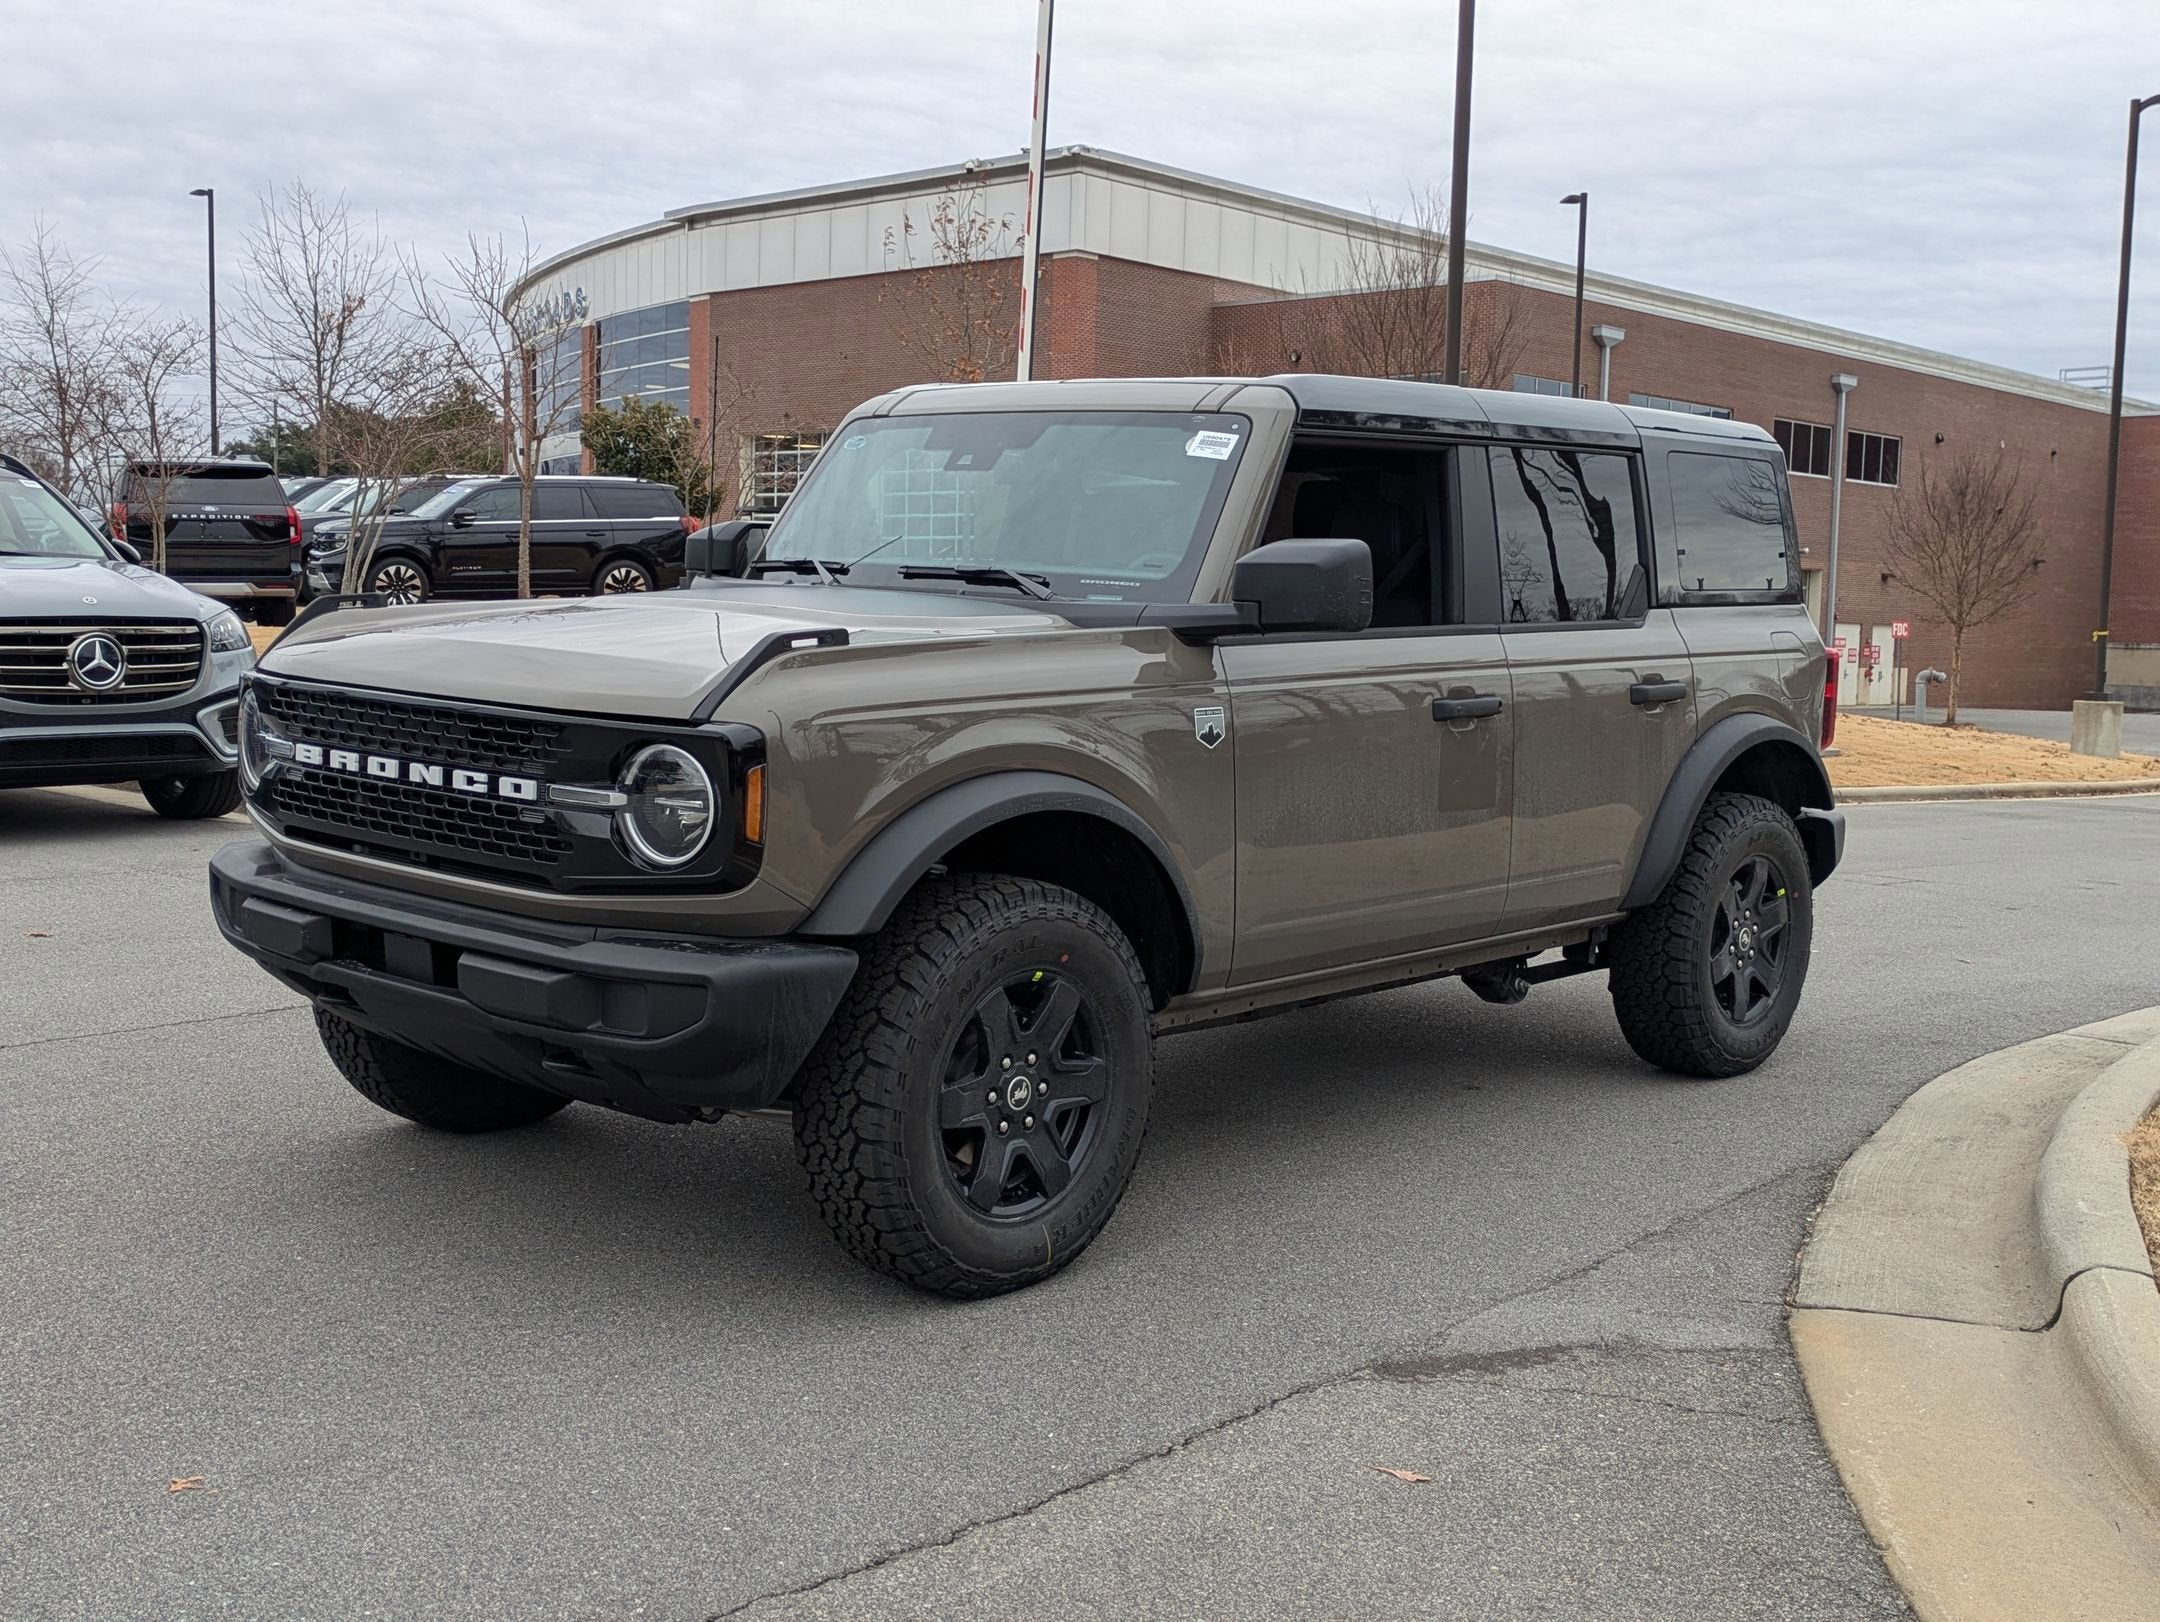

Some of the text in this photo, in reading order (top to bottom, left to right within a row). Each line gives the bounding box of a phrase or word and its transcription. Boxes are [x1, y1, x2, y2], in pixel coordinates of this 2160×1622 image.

[1080, 579, 1141, 587] BRONCO
[1892, 622, 1908, 636] FDC
[295, 743, 537, 801] BRONCO
